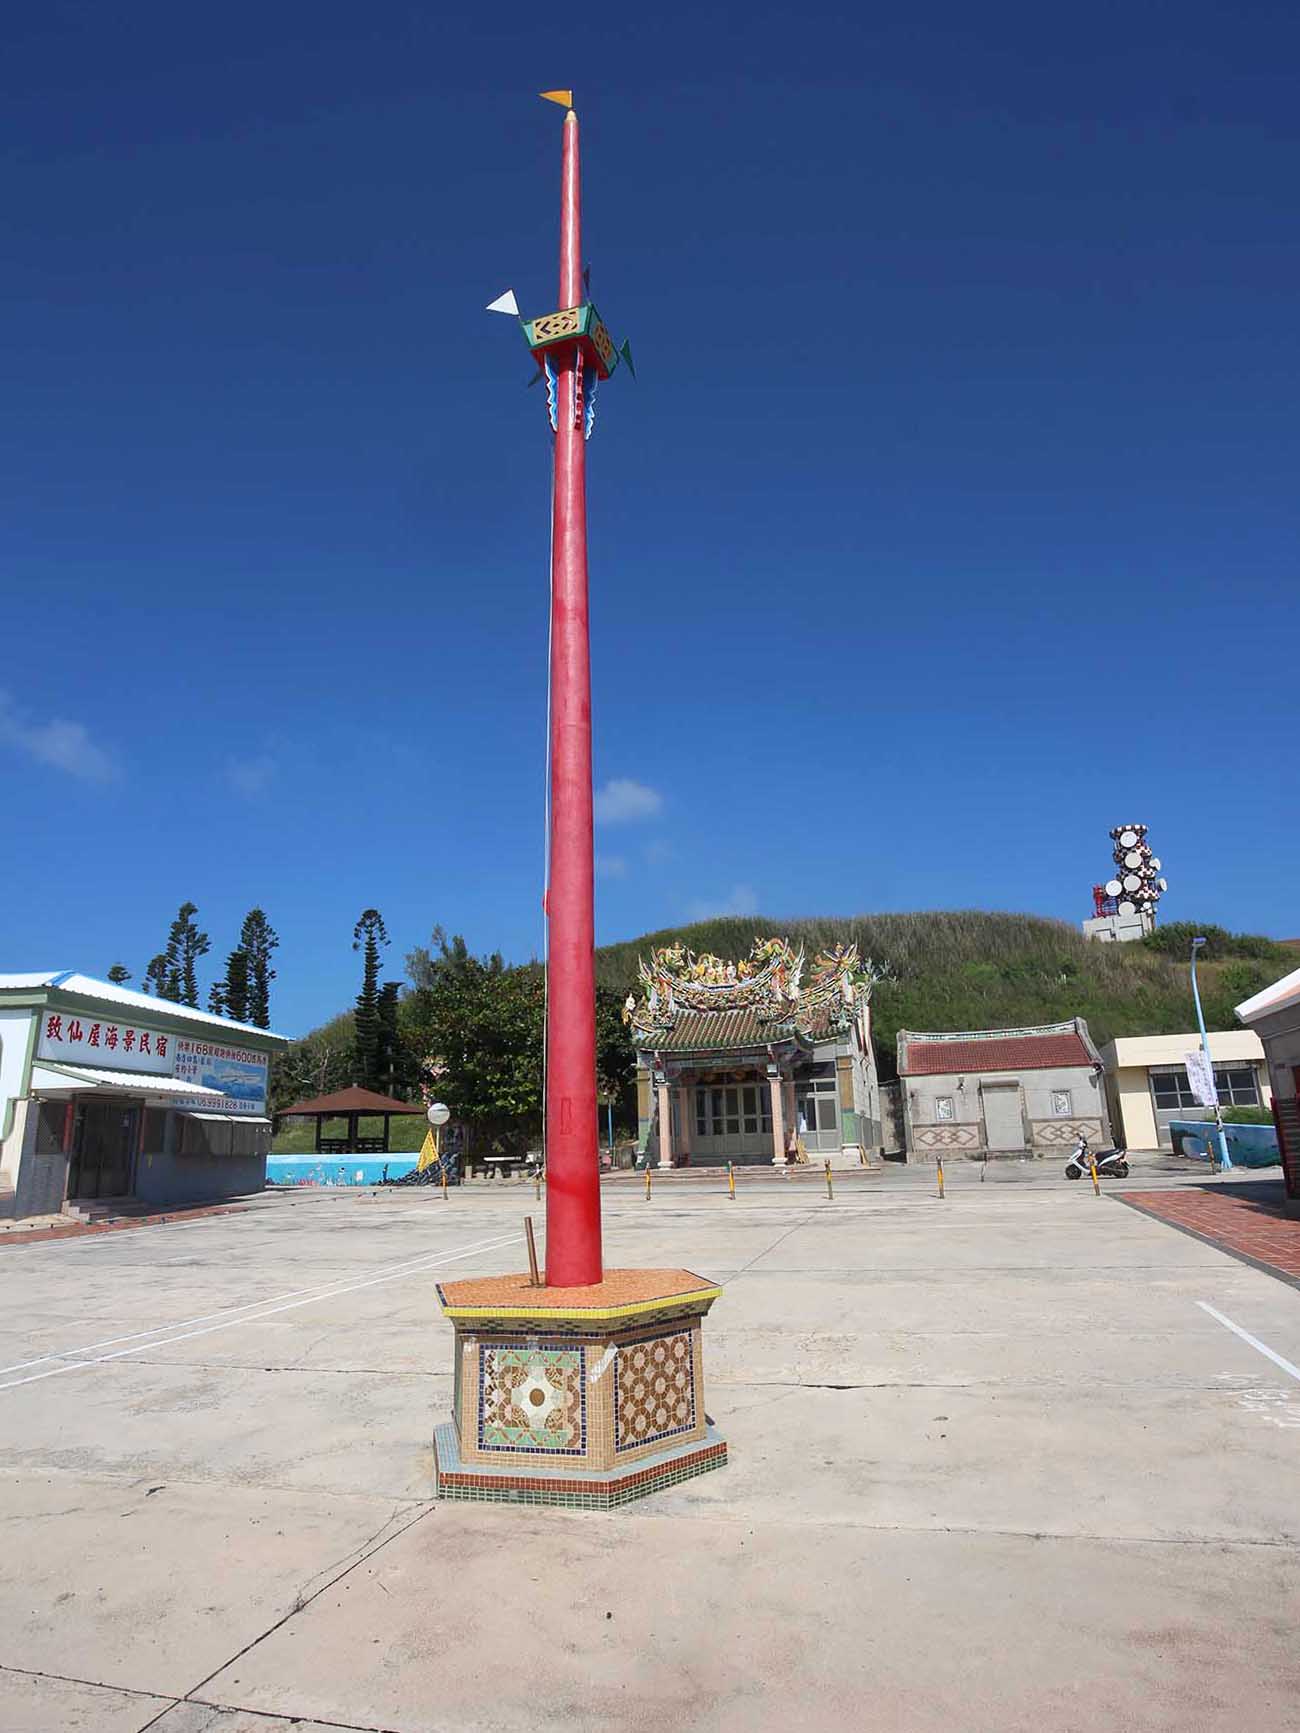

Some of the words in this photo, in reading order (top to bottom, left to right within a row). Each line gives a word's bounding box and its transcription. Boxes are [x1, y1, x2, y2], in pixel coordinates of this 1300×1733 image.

[46, 1015, 168, 1057] 致仙屋海景民宿
